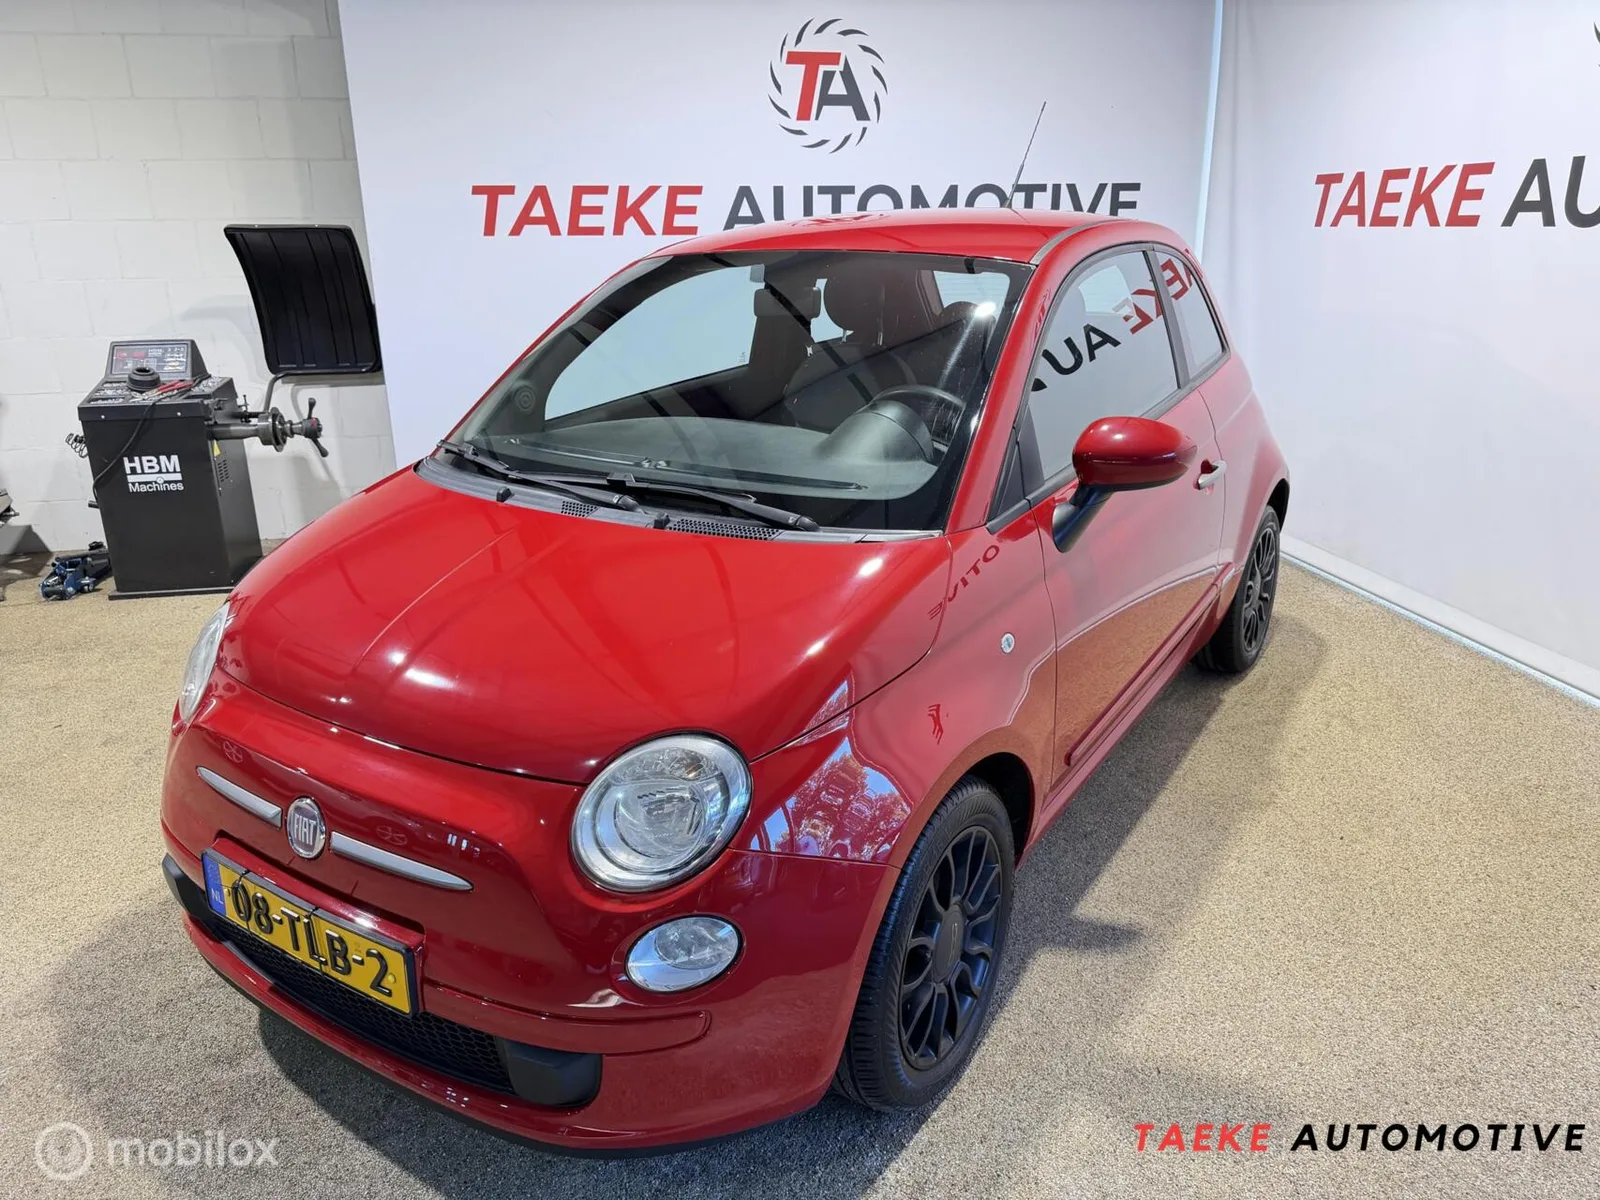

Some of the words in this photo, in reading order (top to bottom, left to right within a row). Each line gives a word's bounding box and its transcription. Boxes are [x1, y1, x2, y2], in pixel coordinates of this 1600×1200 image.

[785, 50, 871, 122] TA
[471, 185, 703, 237] TAEKE
[1314, 162, 1495, 227] TAEKE
[123, 454, 181, 474] HBM
[128, 481, 184, 493] Machines
[294, 813, 317, 846] FIAT
[231, 879, 393, 998] 08-TLB-2
